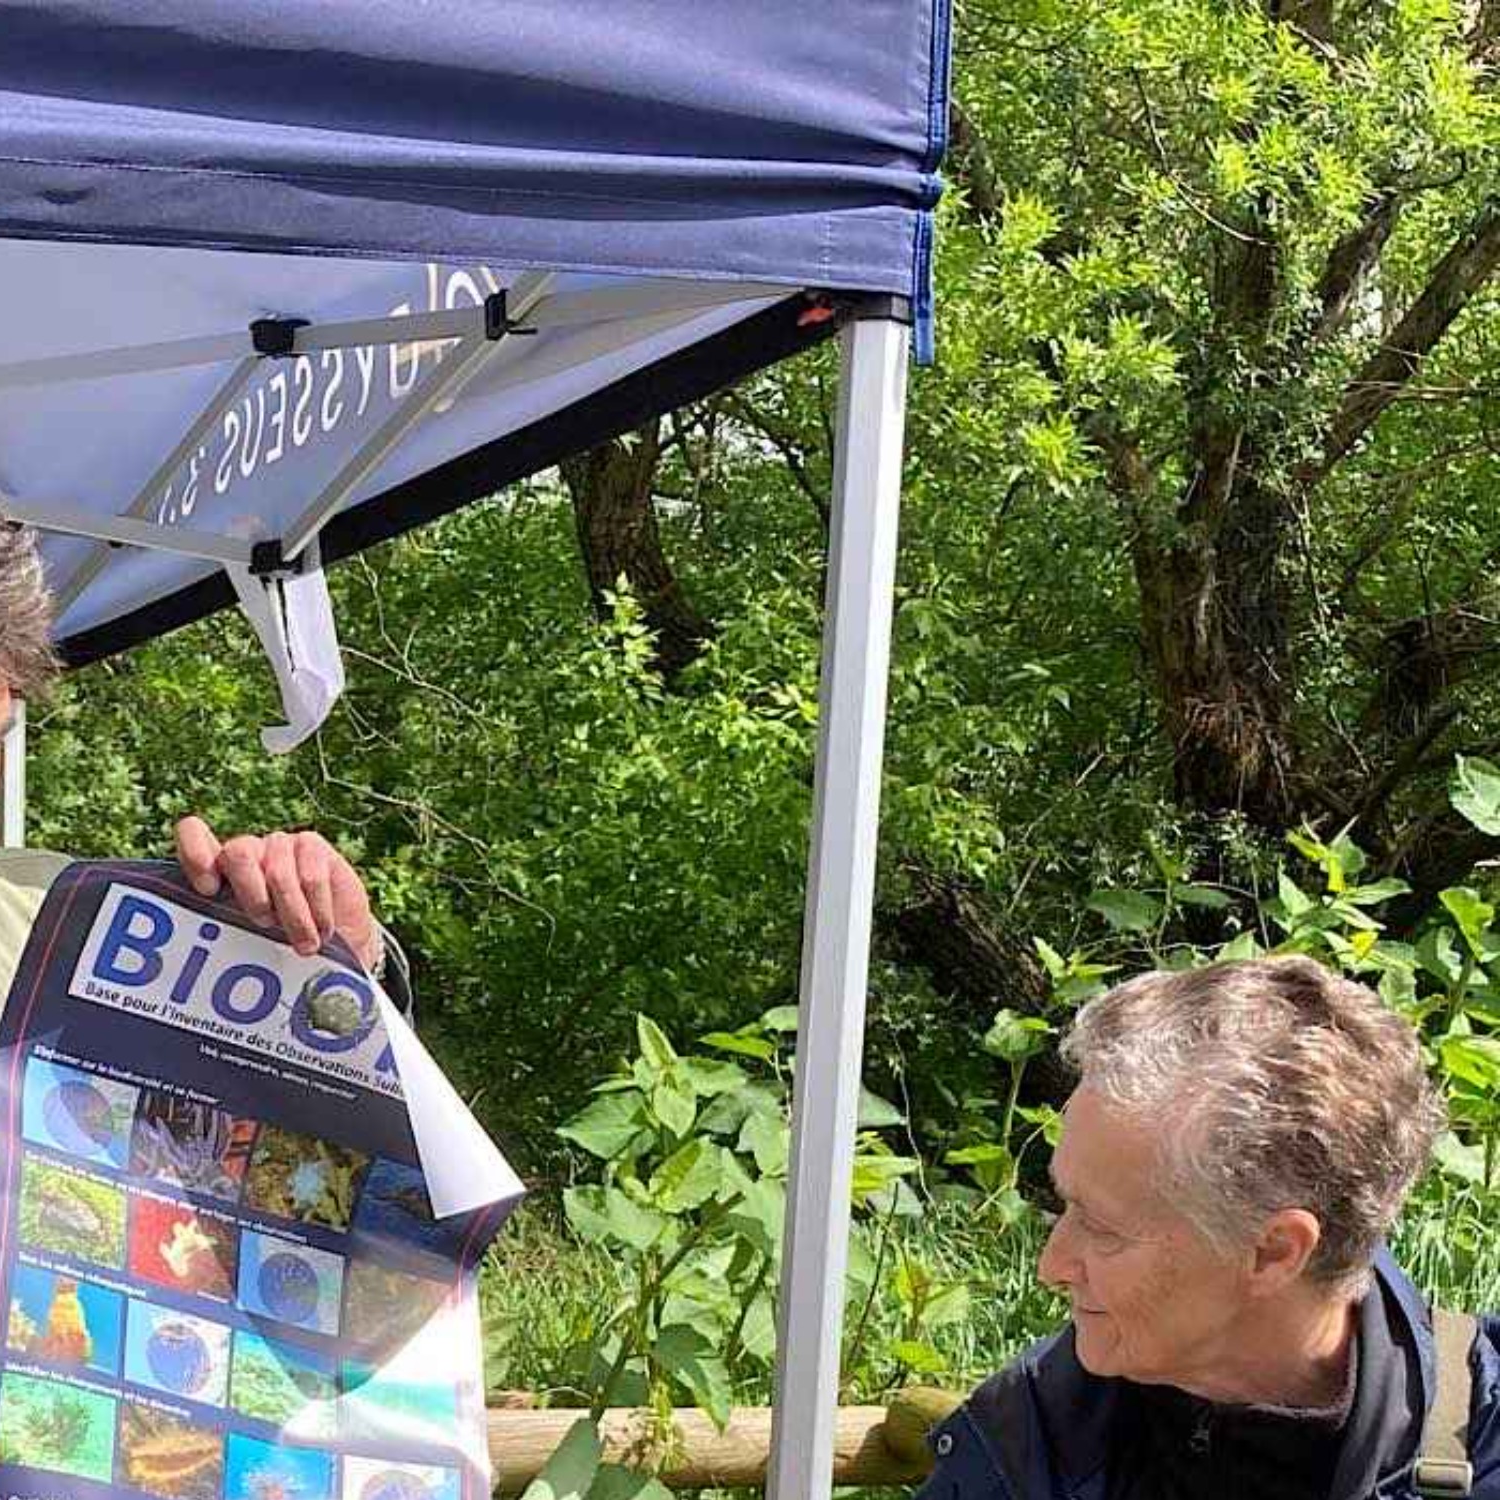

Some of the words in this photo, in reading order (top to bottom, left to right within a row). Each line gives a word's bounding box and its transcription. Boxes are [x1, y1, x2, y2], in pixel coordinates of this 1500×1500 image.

[85, 981, 120, 1002] Base
[121, 994, 161, 1014] pour
[161, 1003, 243, 1041] l'inventaire
[246, 1033, 272, 1050] des
[276, 1042, 369, 1083] Observations
[92, 895, 400, 1078] BioO
